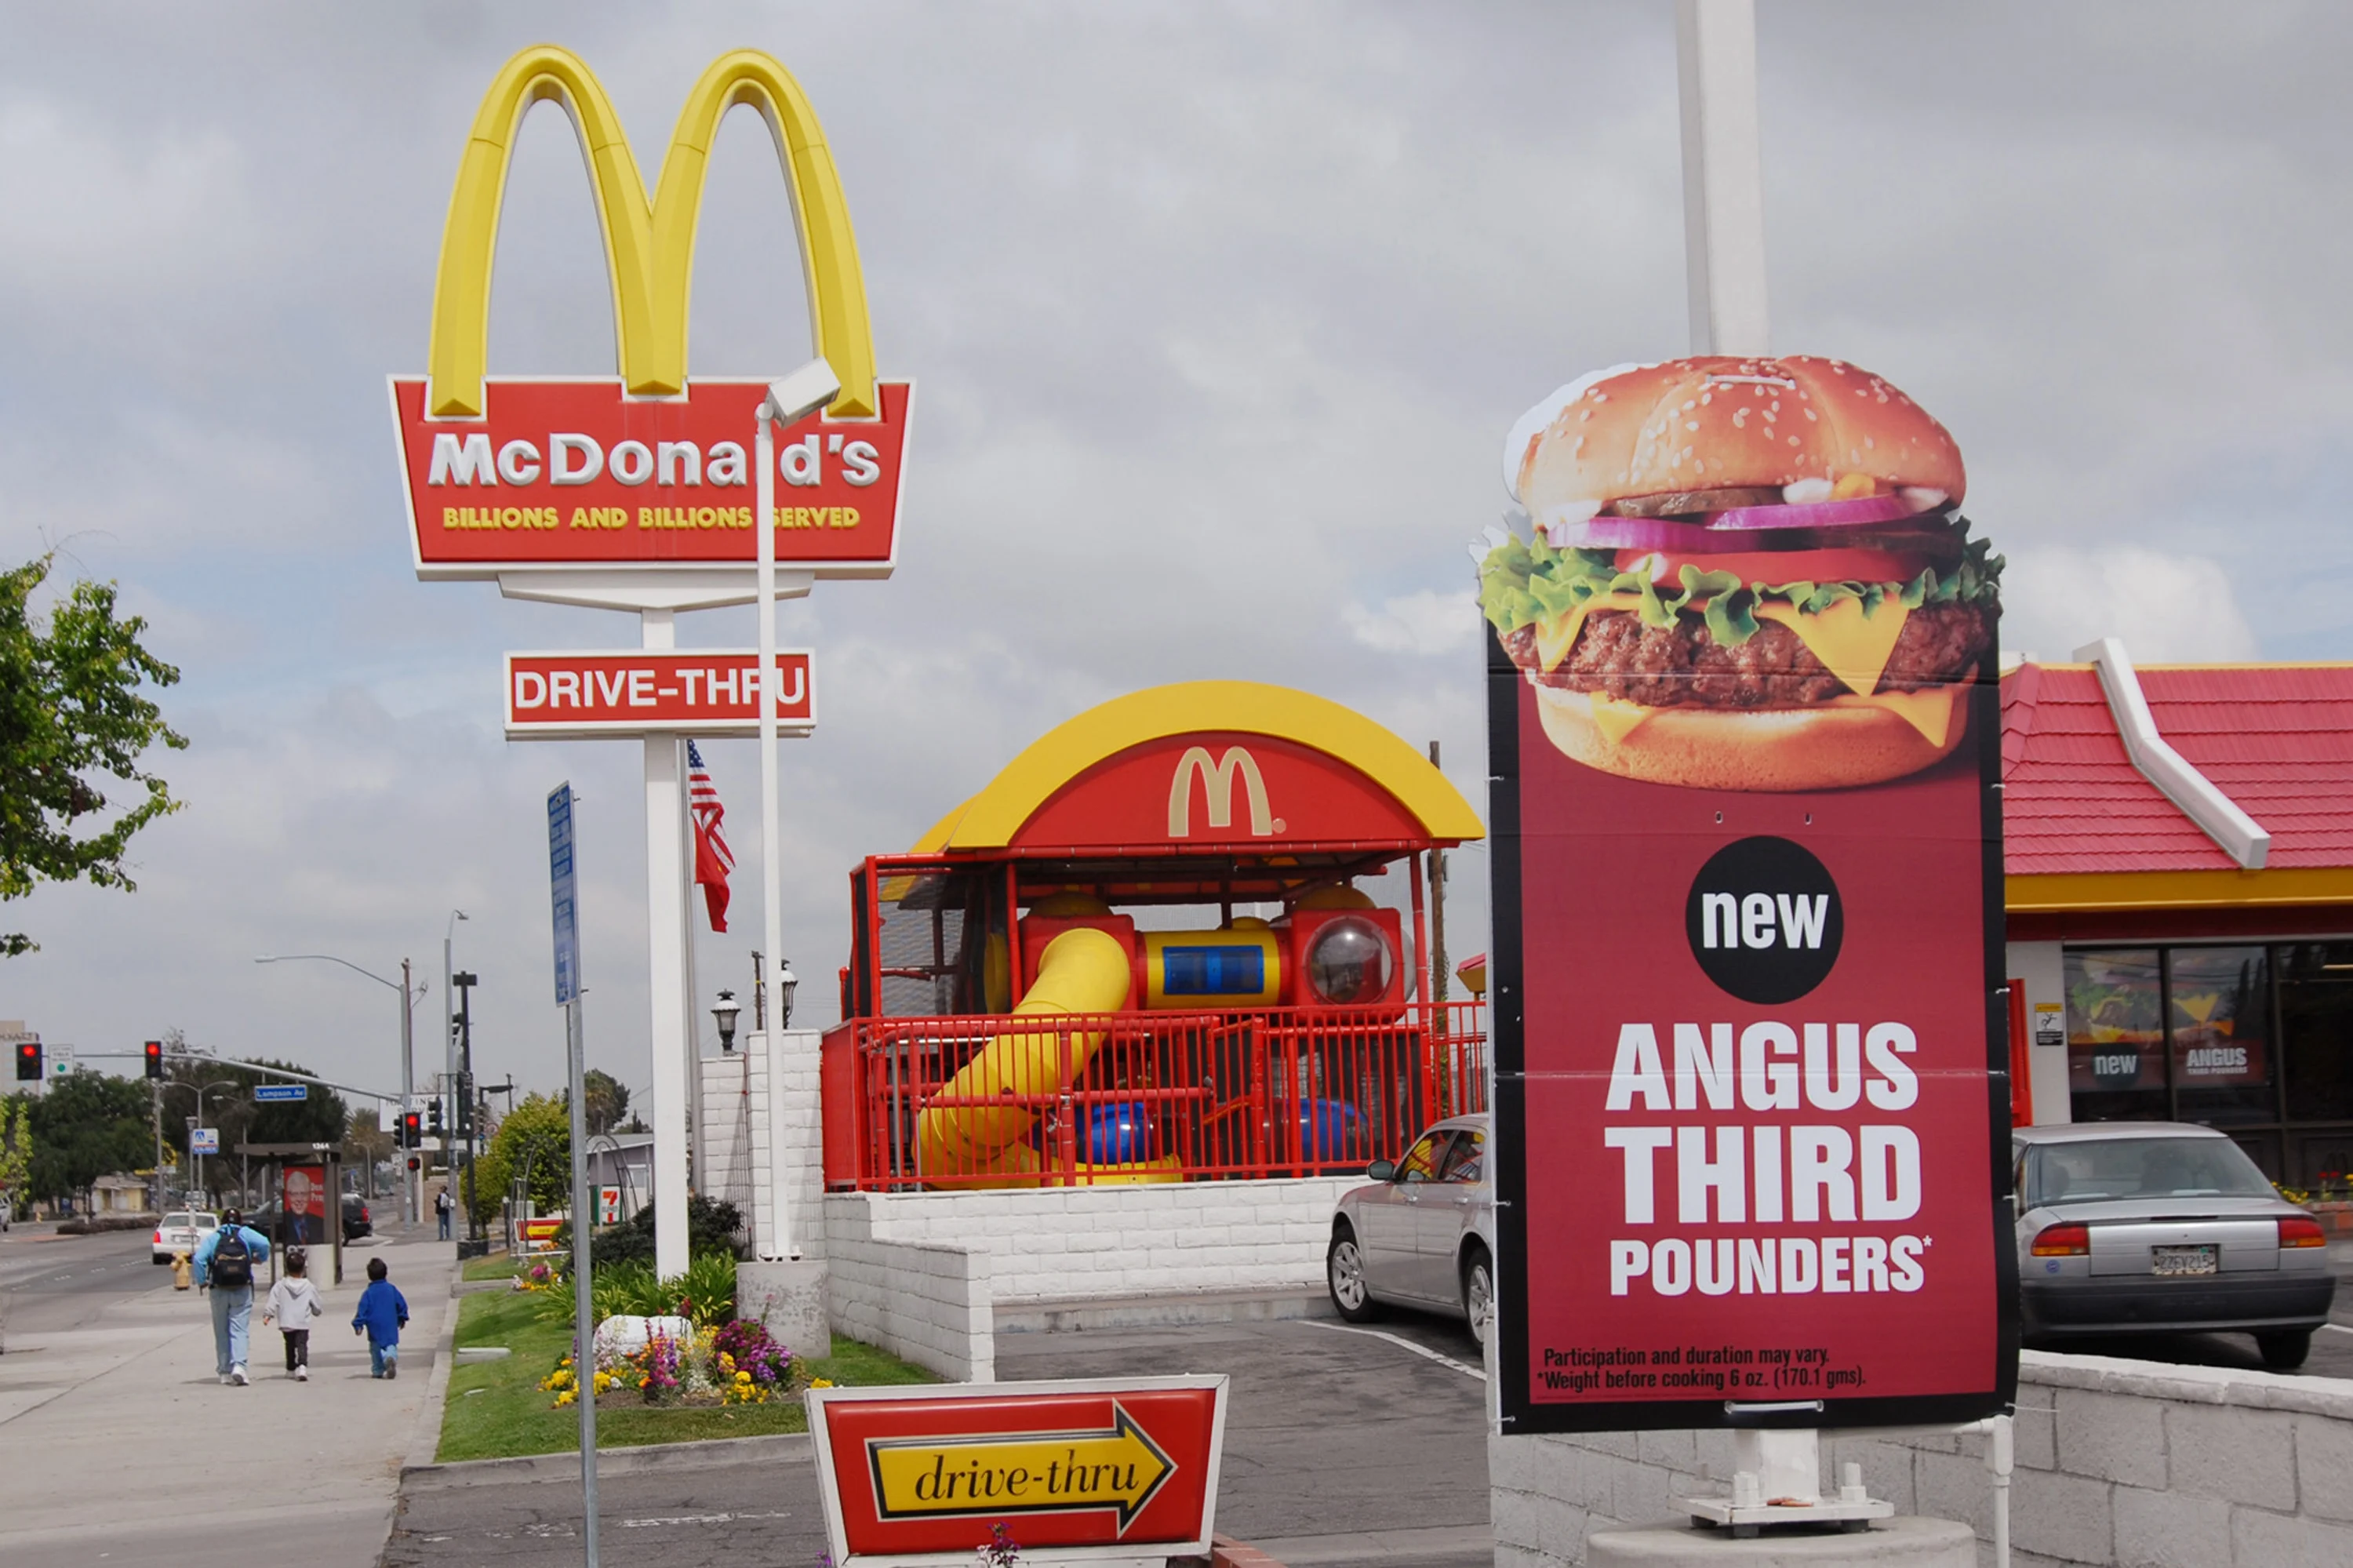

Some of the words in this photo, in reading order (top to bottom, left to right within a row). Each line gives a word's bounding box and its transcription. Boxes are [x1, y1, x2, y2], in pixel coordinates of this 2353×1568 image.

[427, 432, 881, 487] McDonad's
[442, 507, 559, 529] BILLIONS
[569, 507, 627, 529] AND
[638, 506, 753, 529] BILLIONS
[1702, 892, 1829, 949] new
[1604, 1021, 1919, 1111] ANGUS
[2094, 1053, 2137, 1075] new
[2187, 1047, 2248, 1068] ANGUS
[1604, 1125, 1922, 1224] THIRD
[1544, 1347, 1646, 1369] Participation
[1652, 1347, 1681, 1365] and
[1686, 1345, 1754, 1365] duration
[1758, 1348, 1791, 1367] may
[1795, 1348, 1831, 1367] vary.
[1606, 1370, 1657, 1388] before
[1662, 1367, 1725, 1391] cooking
[1729, 1368, 1740, 1388] 6
[1744, 1373, 1769, 1387] oz.
[1773, 1366, 1820, 1391] (170.1
[1826, 1365, 1867, 1390] gms).
[915, 1449, 1140, 1501] drive-thru
